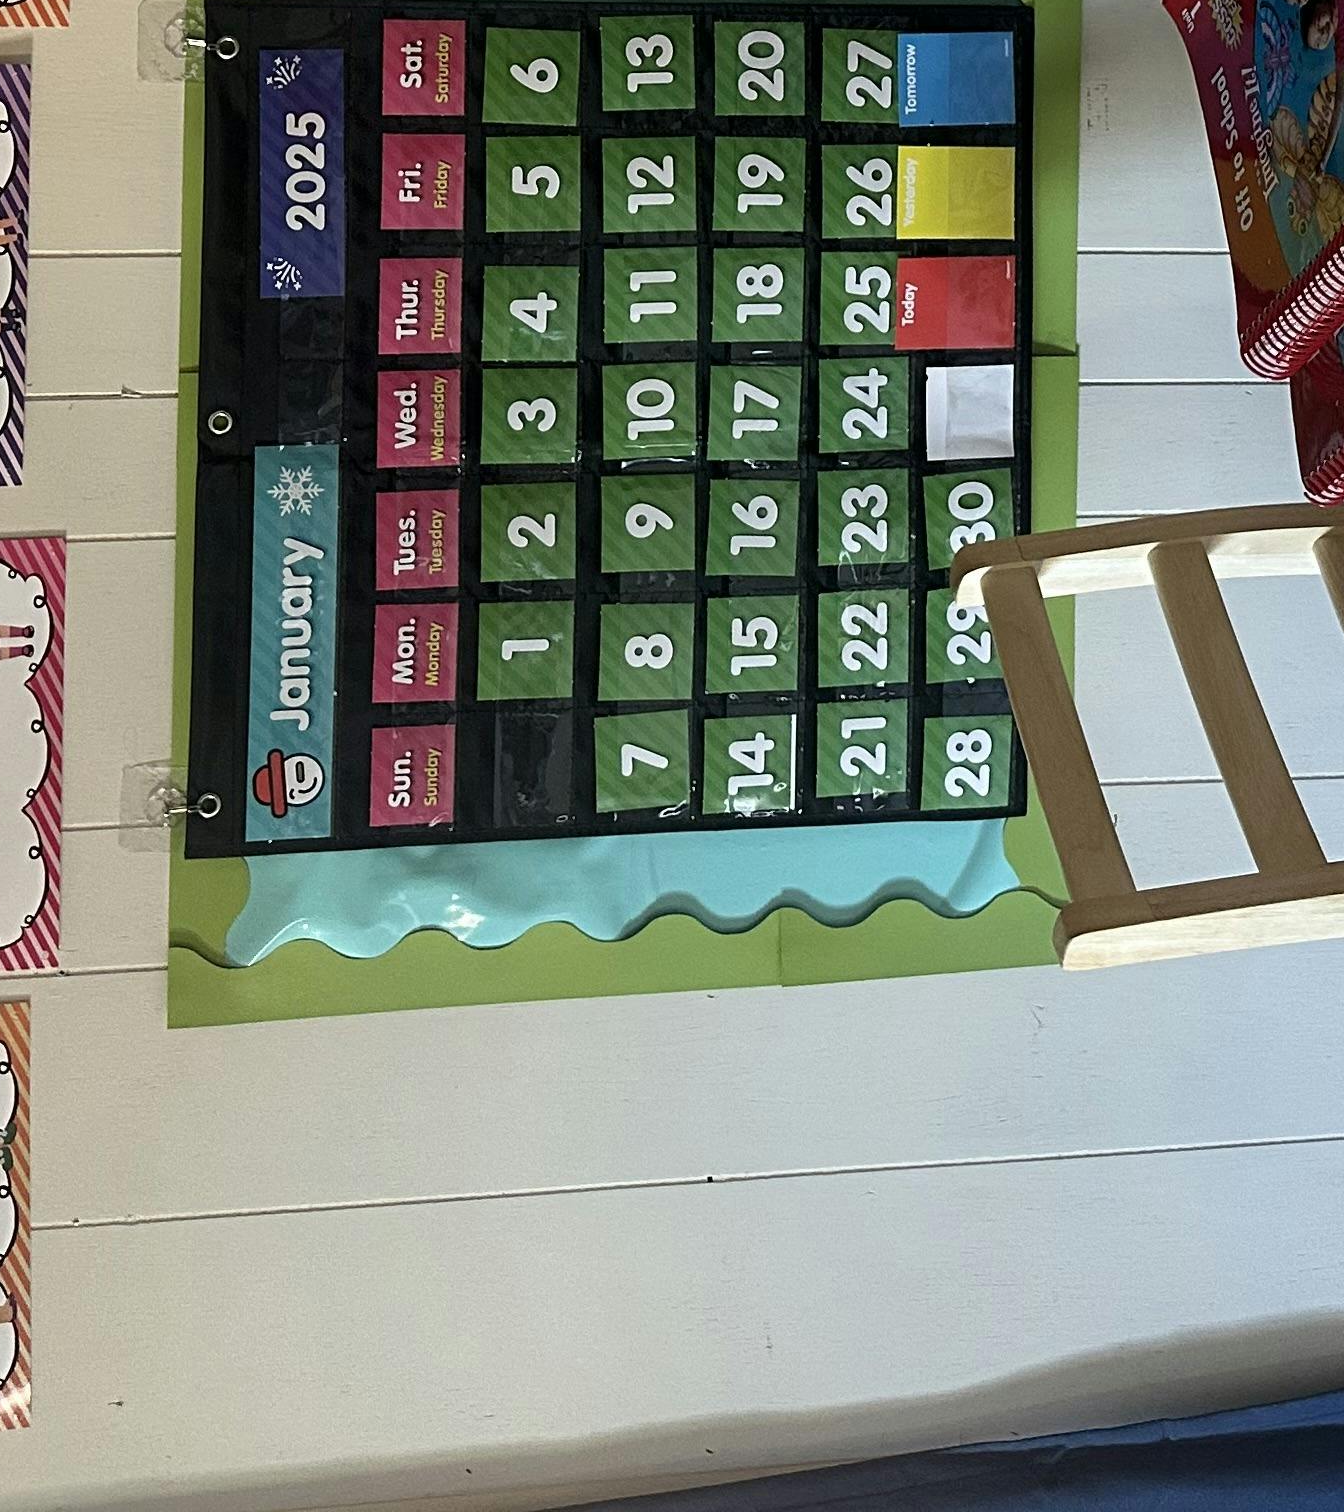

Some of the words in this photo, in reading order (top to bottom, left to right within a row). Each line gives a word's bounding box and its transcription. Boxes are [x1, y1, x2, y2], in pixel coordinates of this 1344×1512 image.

[1181, 8, 1195, 33] Unit
[1190, 1, 1202, 19] 1
[400, 39, 424, 89] Sat.
[434, 33, 452, 104] Saturday
[510, 58, 560, 94] 6
[626, 33, 674, 93] 13
[737, 30, 785, 103] 20
[846, 39, 893, 109] 27
[905, 44, 918, 115] Tomorrow
[1241, 65, 1261, 100] It!
[1210, 65, 1238, 150] School
[285, 112, 326, 232] 2025
[1232, 152, 1246, 181] to
[1250, 98, 1279, 201] Imagine
[398, 162, 423, 203] Fri.
[433, 161, 451, 209] Friday
[511, 164, 561, 199] 5
[626, 155, 675, 214] 12
[737, 153, 785, 213] 19
[845, 157, 893, 226] 26
[903, 157, 918, 227] Yesterday
[1234, 186, 1254, 232] Off
[395, 279, 420, 340] Thur.
[431, 269, 449, 340] Thursday
[509, 291, 558, 334] 4
[629, 269, 678, 323] 11
[736, 264, 784, 324] 18
[843, 265, 891, 334] 25
[901, 282, 917, 326] Today
[394, 383, 418, 449] Wed.
[429, 376, 447, 460] Wednesday
[506, 397, 557, 432] 3
[626, 378, 676, 440] 10
[732, 380, 780, 439] 17
[842, 368, 889, 440] 24
[394, 510, 417, 575] Tues.
[428, 509, 446, 574] Tuesday
[506, 513, 557, 548] 2
[625, 503, 674, 539] 9
[729, 494, 779, 556] 16
[841, 483, 889, 553] 23
[948, 481, 996, 554] 30
[269, 537, 325, 732] January
[391, 618, 417, 684] Mon.
[426, 623, 444, 686] Monday
[501, 639, 550, 662] 1
[624, 633, 674, 669] 8
[729, 616, 779, 676] 15
[841, 602, 888, 672] 22
[946, 600, 991, 665] 29
[424, 748, 442, 806] Sunday
[620, 744, 669, 777] 7
[727, 732, 776, 796] 14
[840, 717, 888, 777] 21
[944, 728, 993, 798] 28
[387, 750, 413, 808] Sun.
